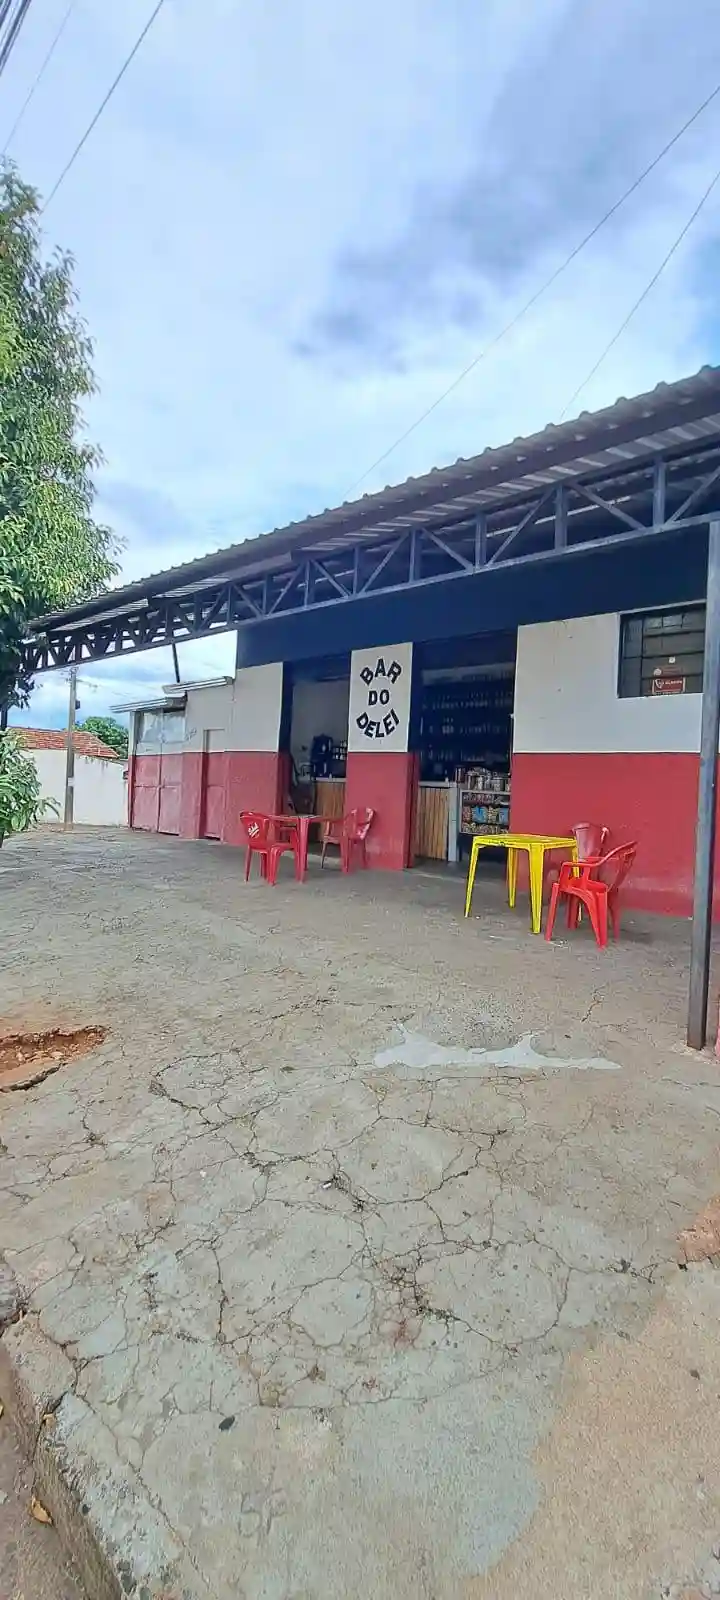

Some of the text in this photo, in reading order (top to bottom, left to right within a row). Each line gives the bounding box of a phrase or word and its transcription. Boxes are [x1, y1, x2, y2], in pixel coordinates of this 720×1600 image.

[360, 658, 402, 685] BAR
[368, 689, 390, 706] DO
[356, 708, 400, 738] DELEI
